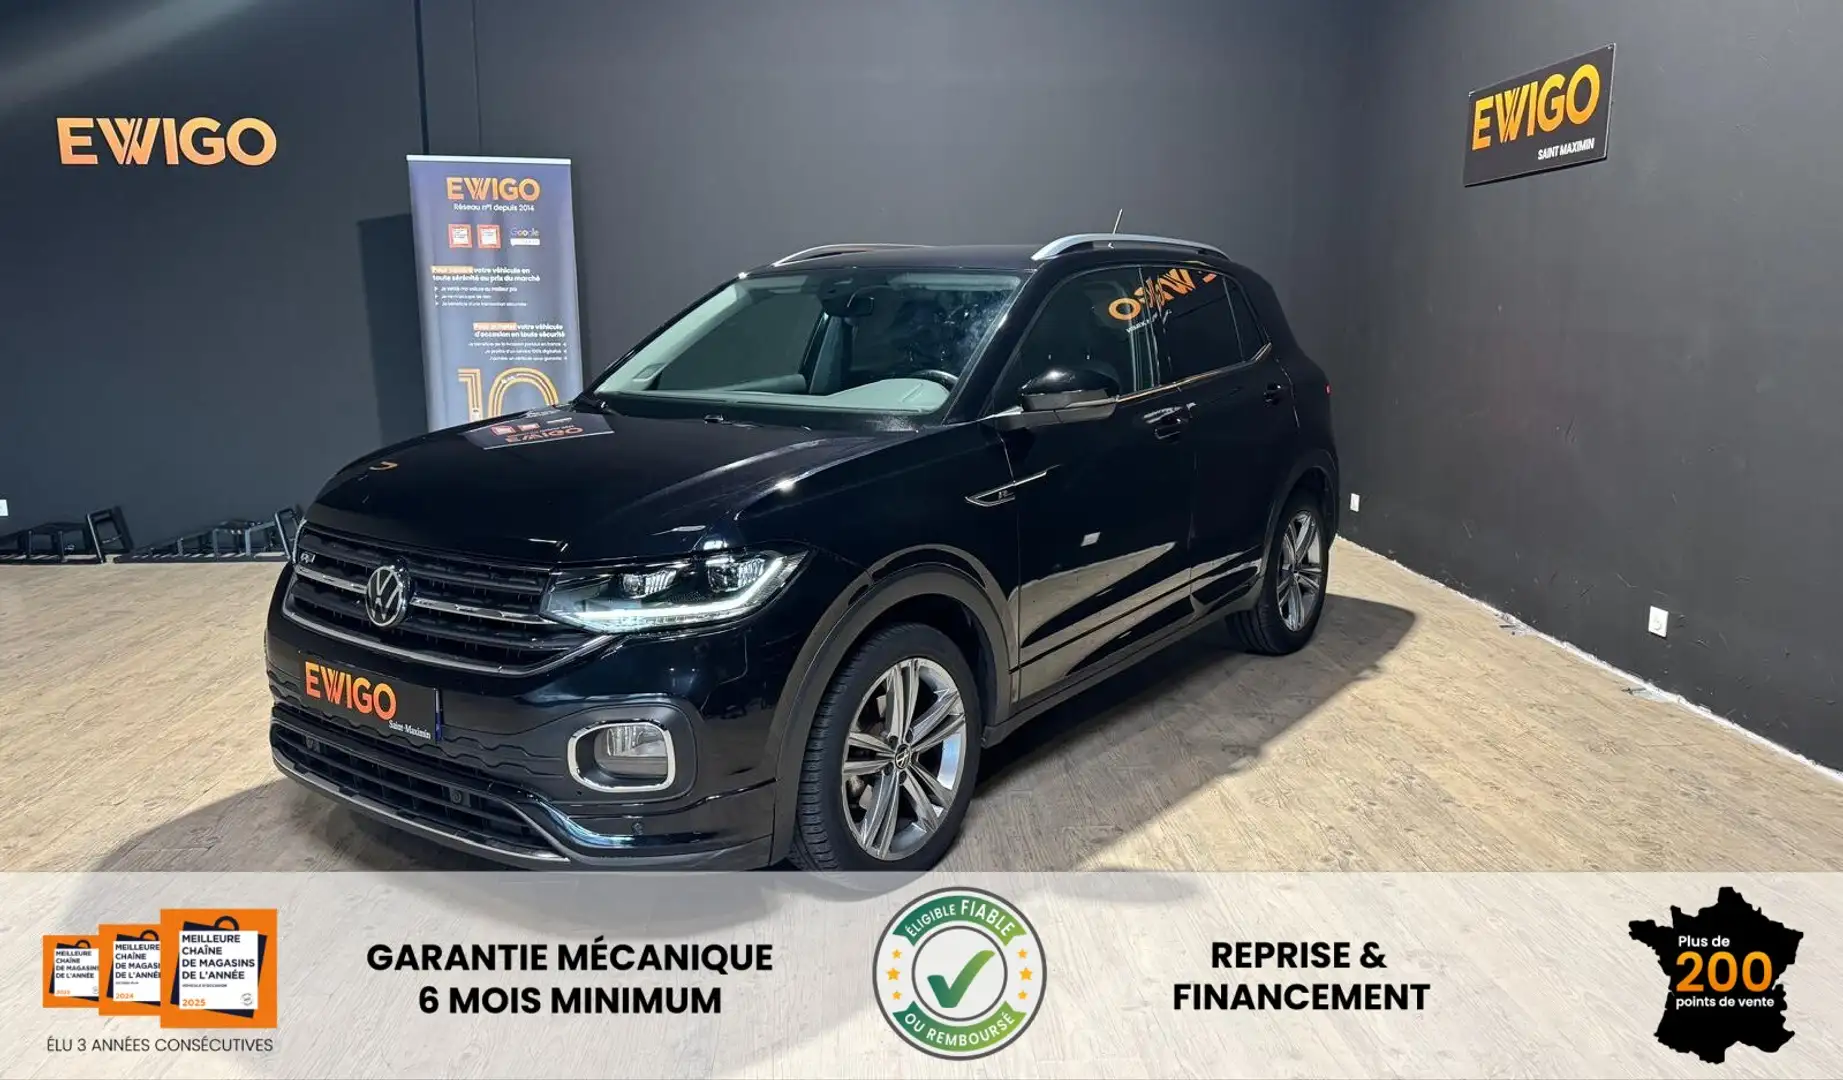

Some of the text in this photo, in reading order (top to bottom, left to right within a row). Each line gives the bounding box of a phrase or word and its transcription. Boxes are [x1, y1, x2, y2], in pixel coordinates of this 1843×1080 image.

[1471, 64, 1600, 151] EWIGO
[56, 117, 277, 166] EWIGO
[1537, 137, 1595, 160] SAINT MAXIMIN
[446, 177, 540, 201] EWIGO
[305, 661, 396, 720] EWIGO
